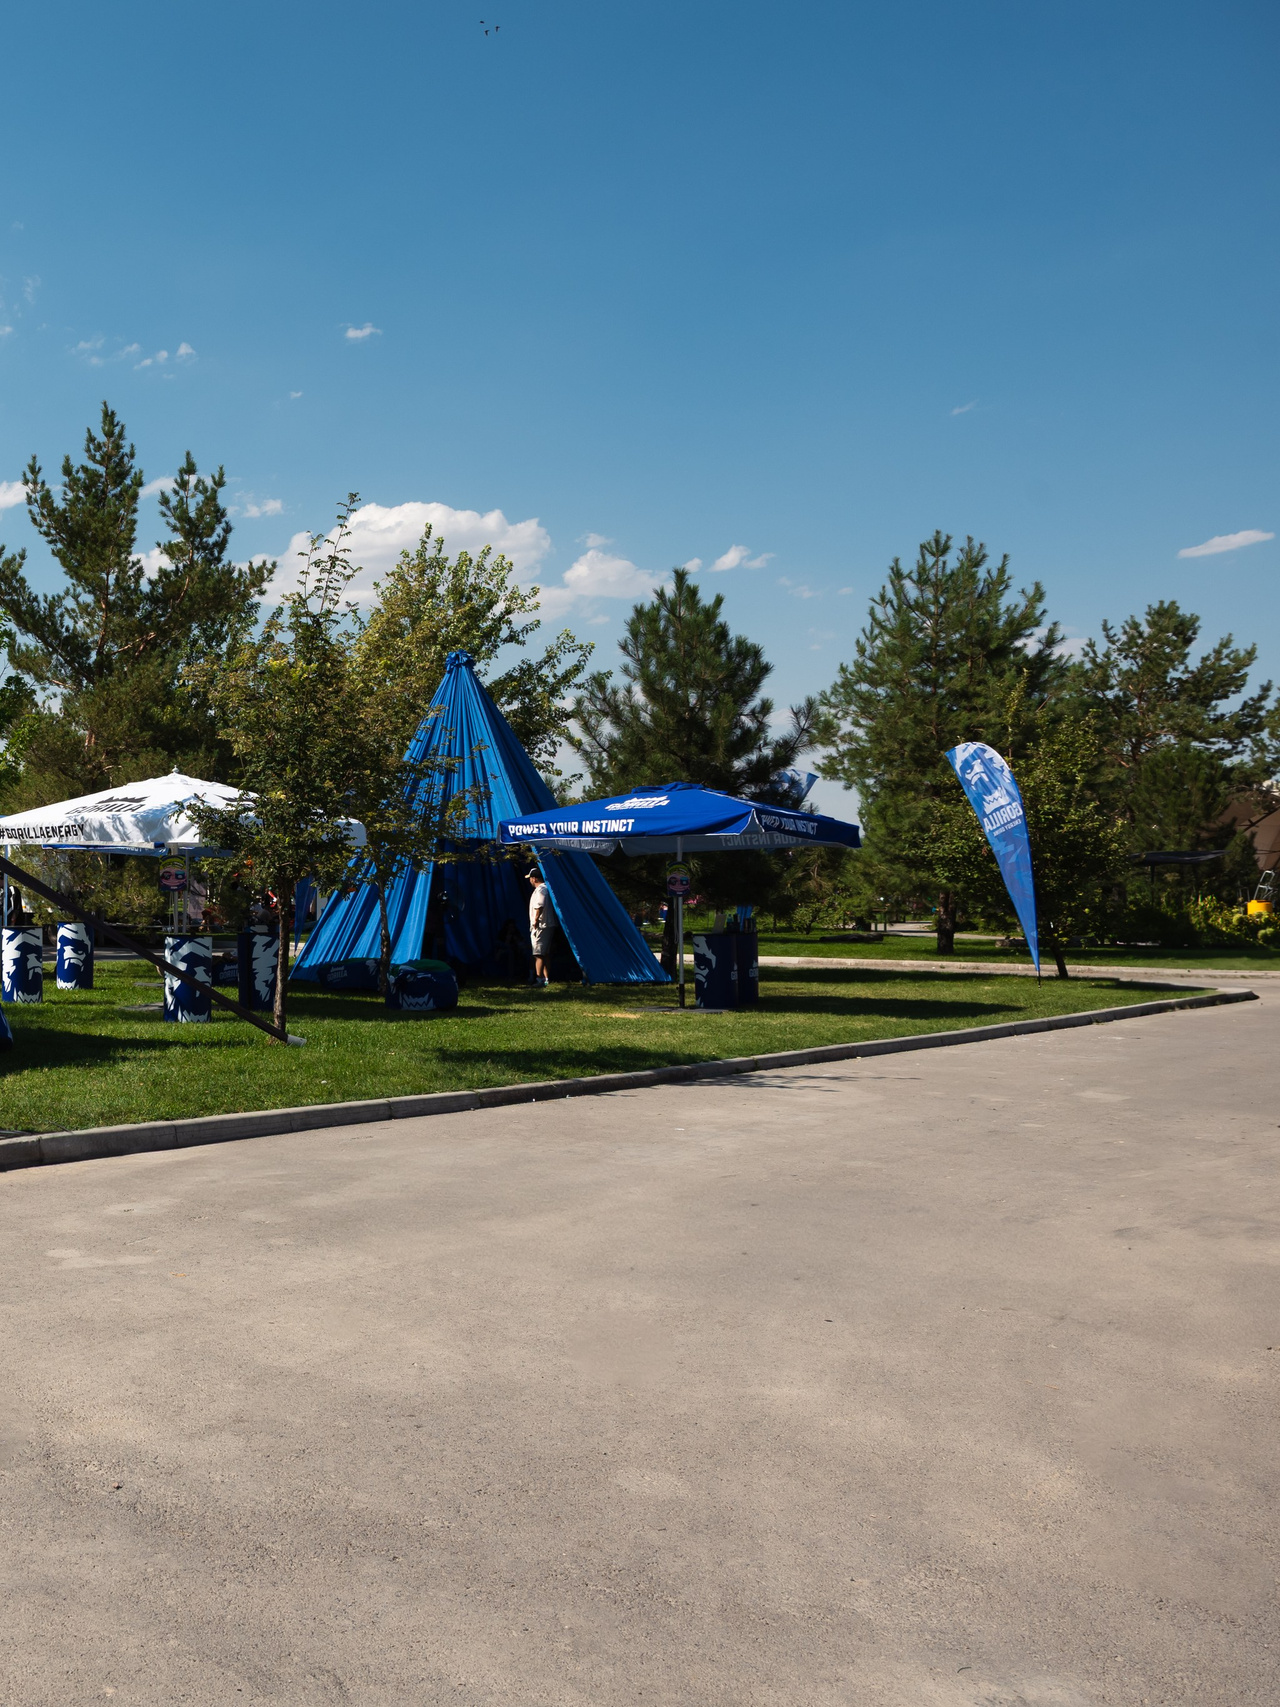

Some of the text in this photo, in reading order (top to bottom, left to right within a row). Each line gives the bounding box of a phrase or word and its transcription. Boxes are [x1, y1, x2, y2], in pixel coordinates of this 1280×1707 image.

[65, 803, 146, 815] GORILLA
[508, 818, 635, 837] POWER YOUR INSTINCT
